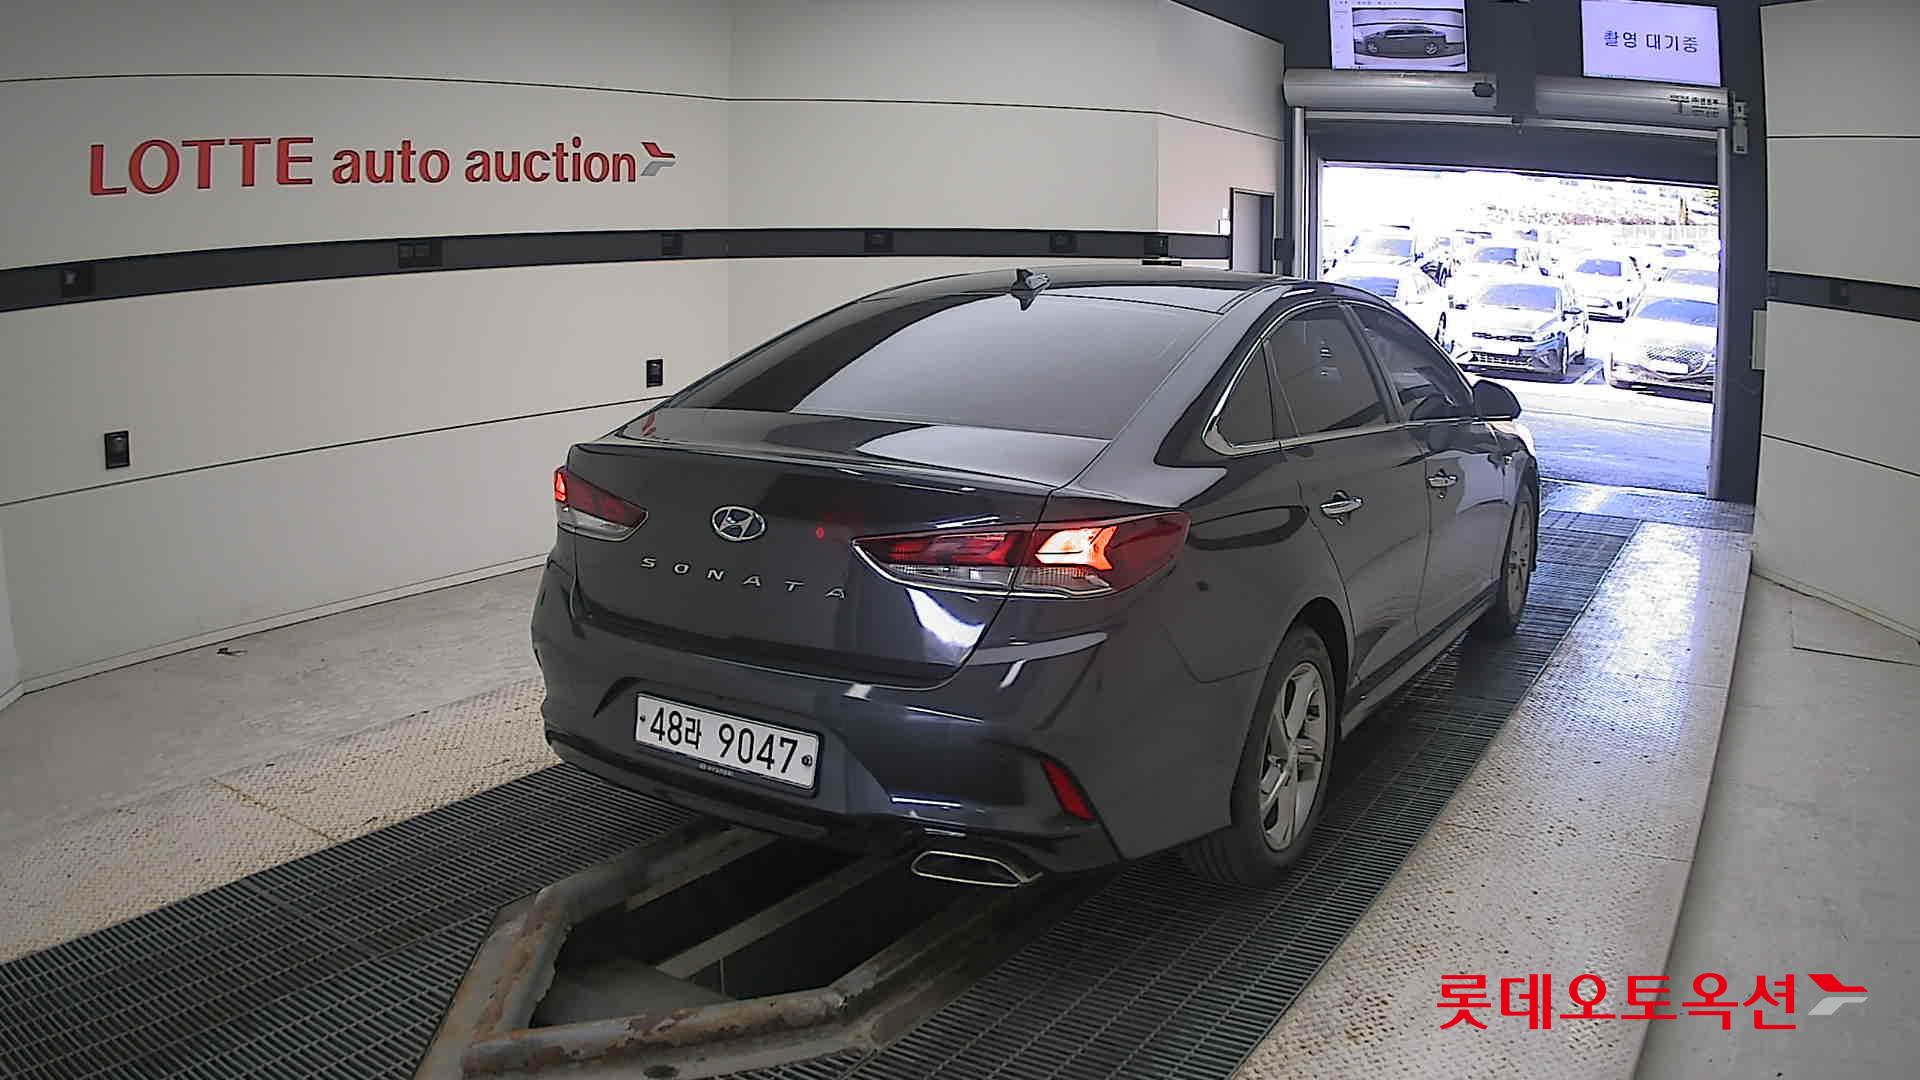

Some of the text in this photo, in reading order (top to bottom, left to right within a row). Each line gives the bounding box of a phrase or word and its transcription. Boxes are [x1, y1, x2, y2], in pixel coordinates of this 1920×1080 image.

[1645, 33, 1698, 53] 대기중
[90, 136, 637, 196] LOTTE auto auction
[641, 556, 846, 600] SONATA
[650, 707, 798, 774] 48라 9047
